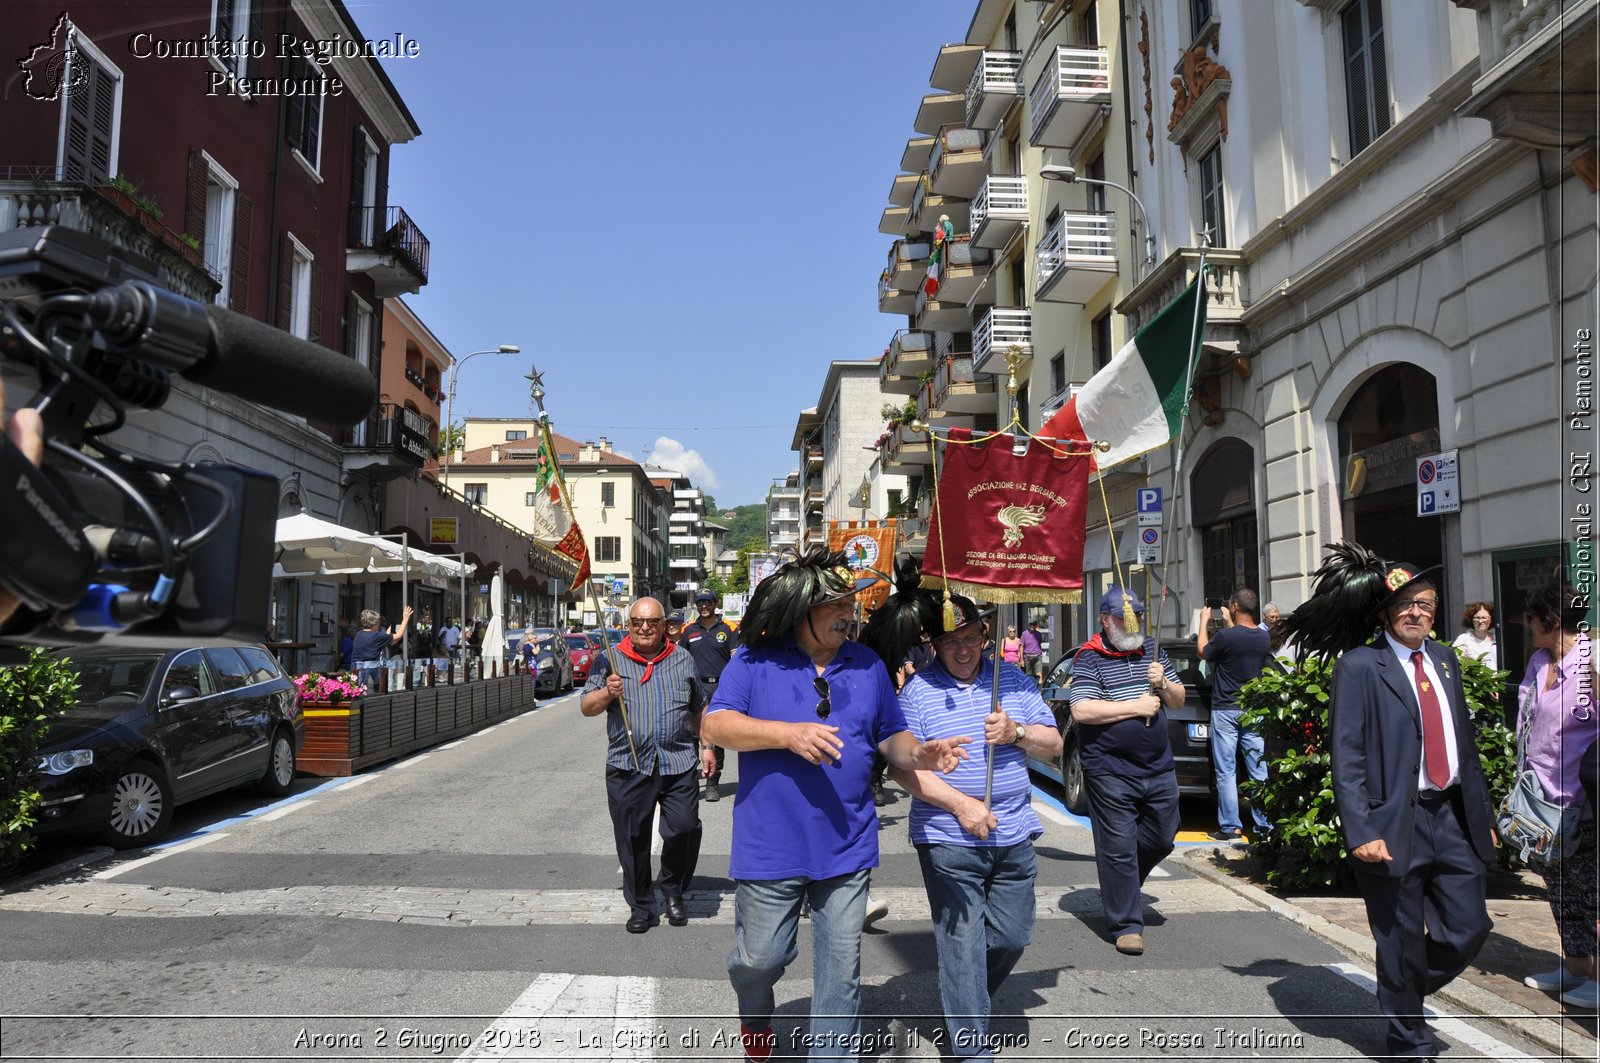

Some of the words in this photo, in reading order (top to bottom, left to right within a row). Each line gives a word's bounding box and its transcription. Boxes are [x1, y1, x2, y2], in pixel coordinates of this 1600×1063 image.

[967, 481, 1014, 500] ASSOCIAZIONE
[1142, 490, 1157, 511] P
[1423, 494, 1433, 511] P
